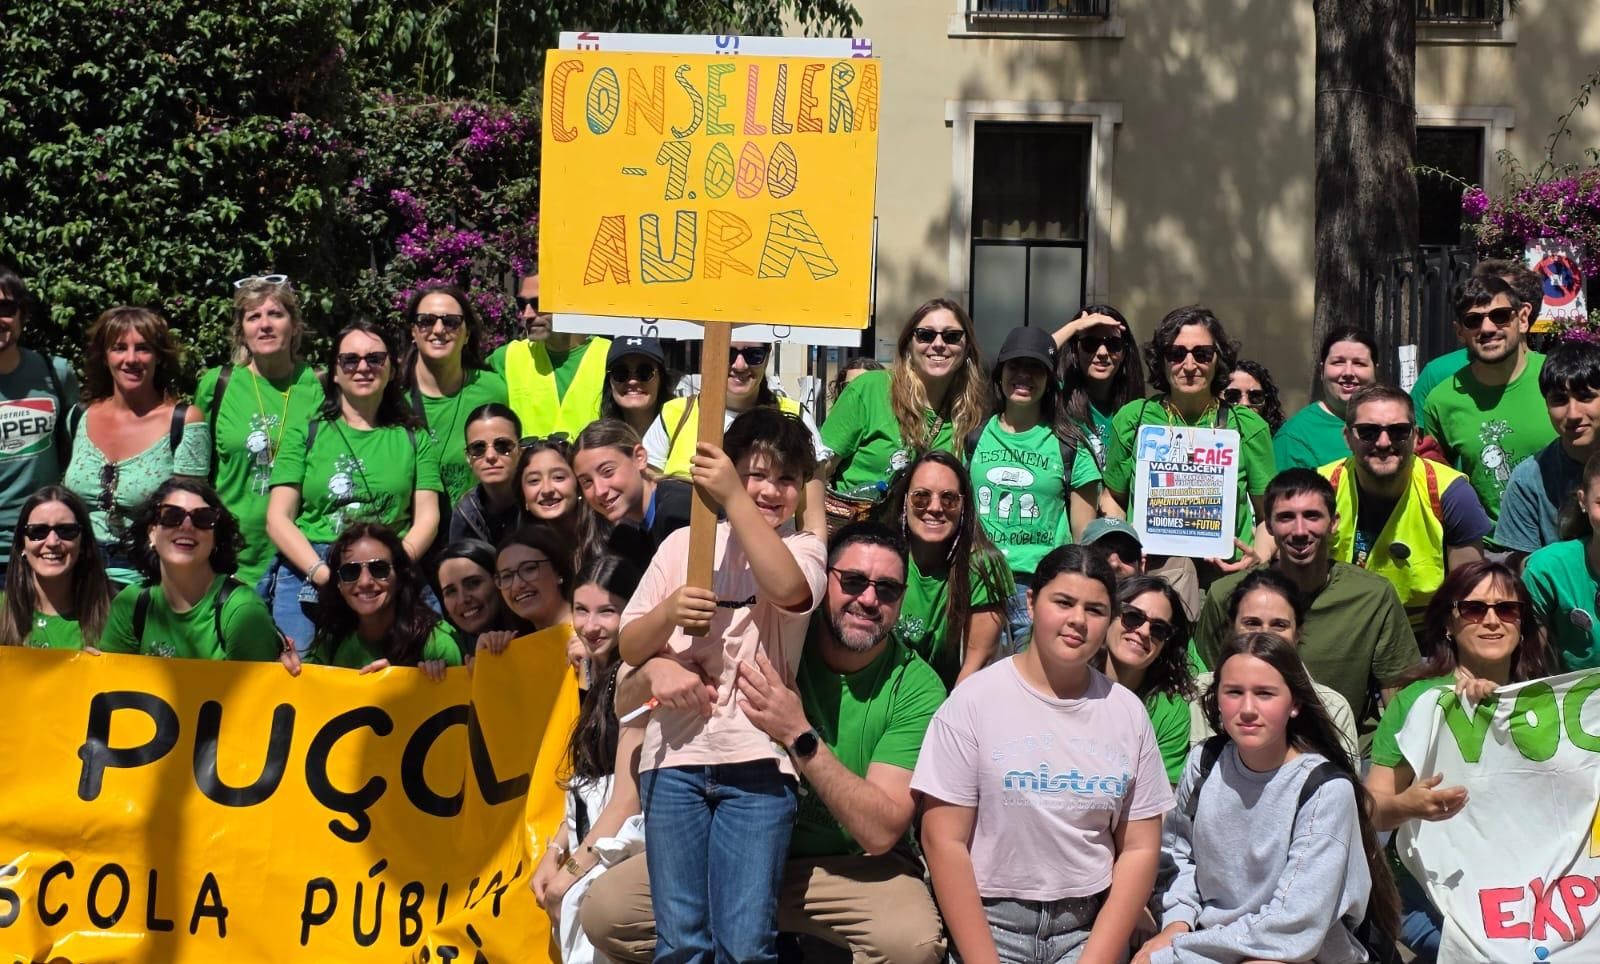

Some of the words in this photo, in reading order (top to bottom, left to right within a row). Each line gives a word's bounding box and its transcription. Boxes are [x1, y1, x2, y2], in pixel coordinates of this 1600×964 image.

[551, 60, 878, 142] CONSELLERA
[621, 141, 799, 200] -1.000
[583, 209, 839, 286] AURA
[981, 449, 1049, 470] ESTIMEM
[1150, 462, 1179, 472] VAGA
[1181, 464, 1223, 474] DOCENT
[1004, 761, 1130, 798] mistral
[1478, 875, 1600, 942] EXP
